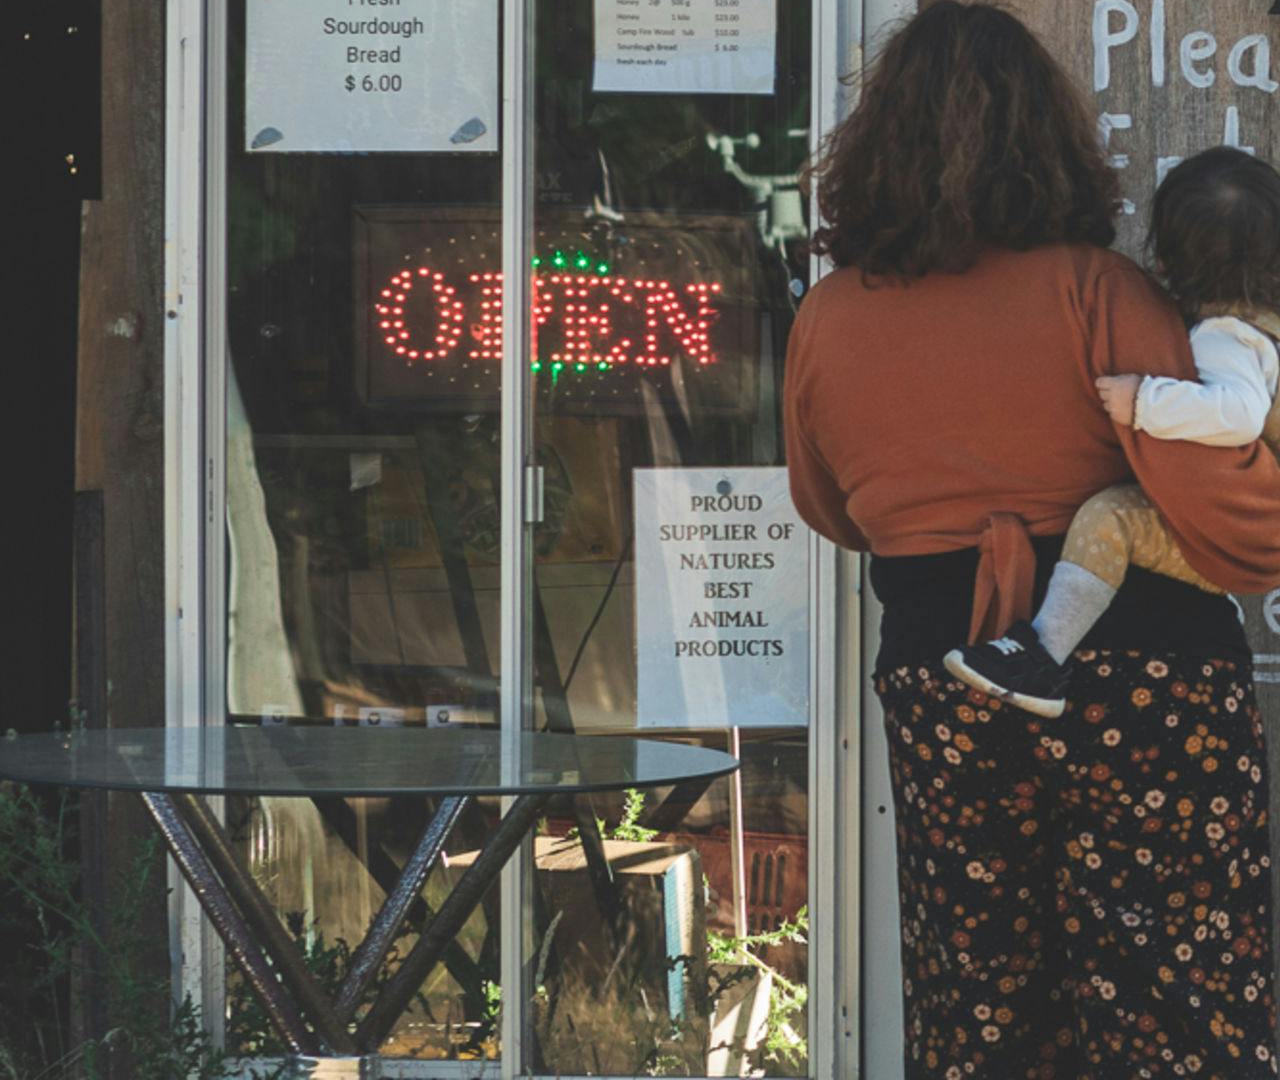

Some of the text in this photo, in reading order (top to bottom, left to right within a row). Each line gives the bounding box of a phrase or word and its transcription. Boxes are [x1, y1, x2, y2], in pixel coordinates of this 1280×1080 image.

[324, 17, 423, 38] Sourdough
[347, 45, 401, 63] Bread
[345, 74, 402, 92] $ 6.00
[691, 494, 762, 512] PROUD
[660, 523, 794, 541] SUPPLIER OF
[681, 552, 775, 569] NATURES
[705, 582, 753, 598] BEST
[690, 611, 768, 627] ANIMAL
[675, 640, 784, 659] PRODUCTS
